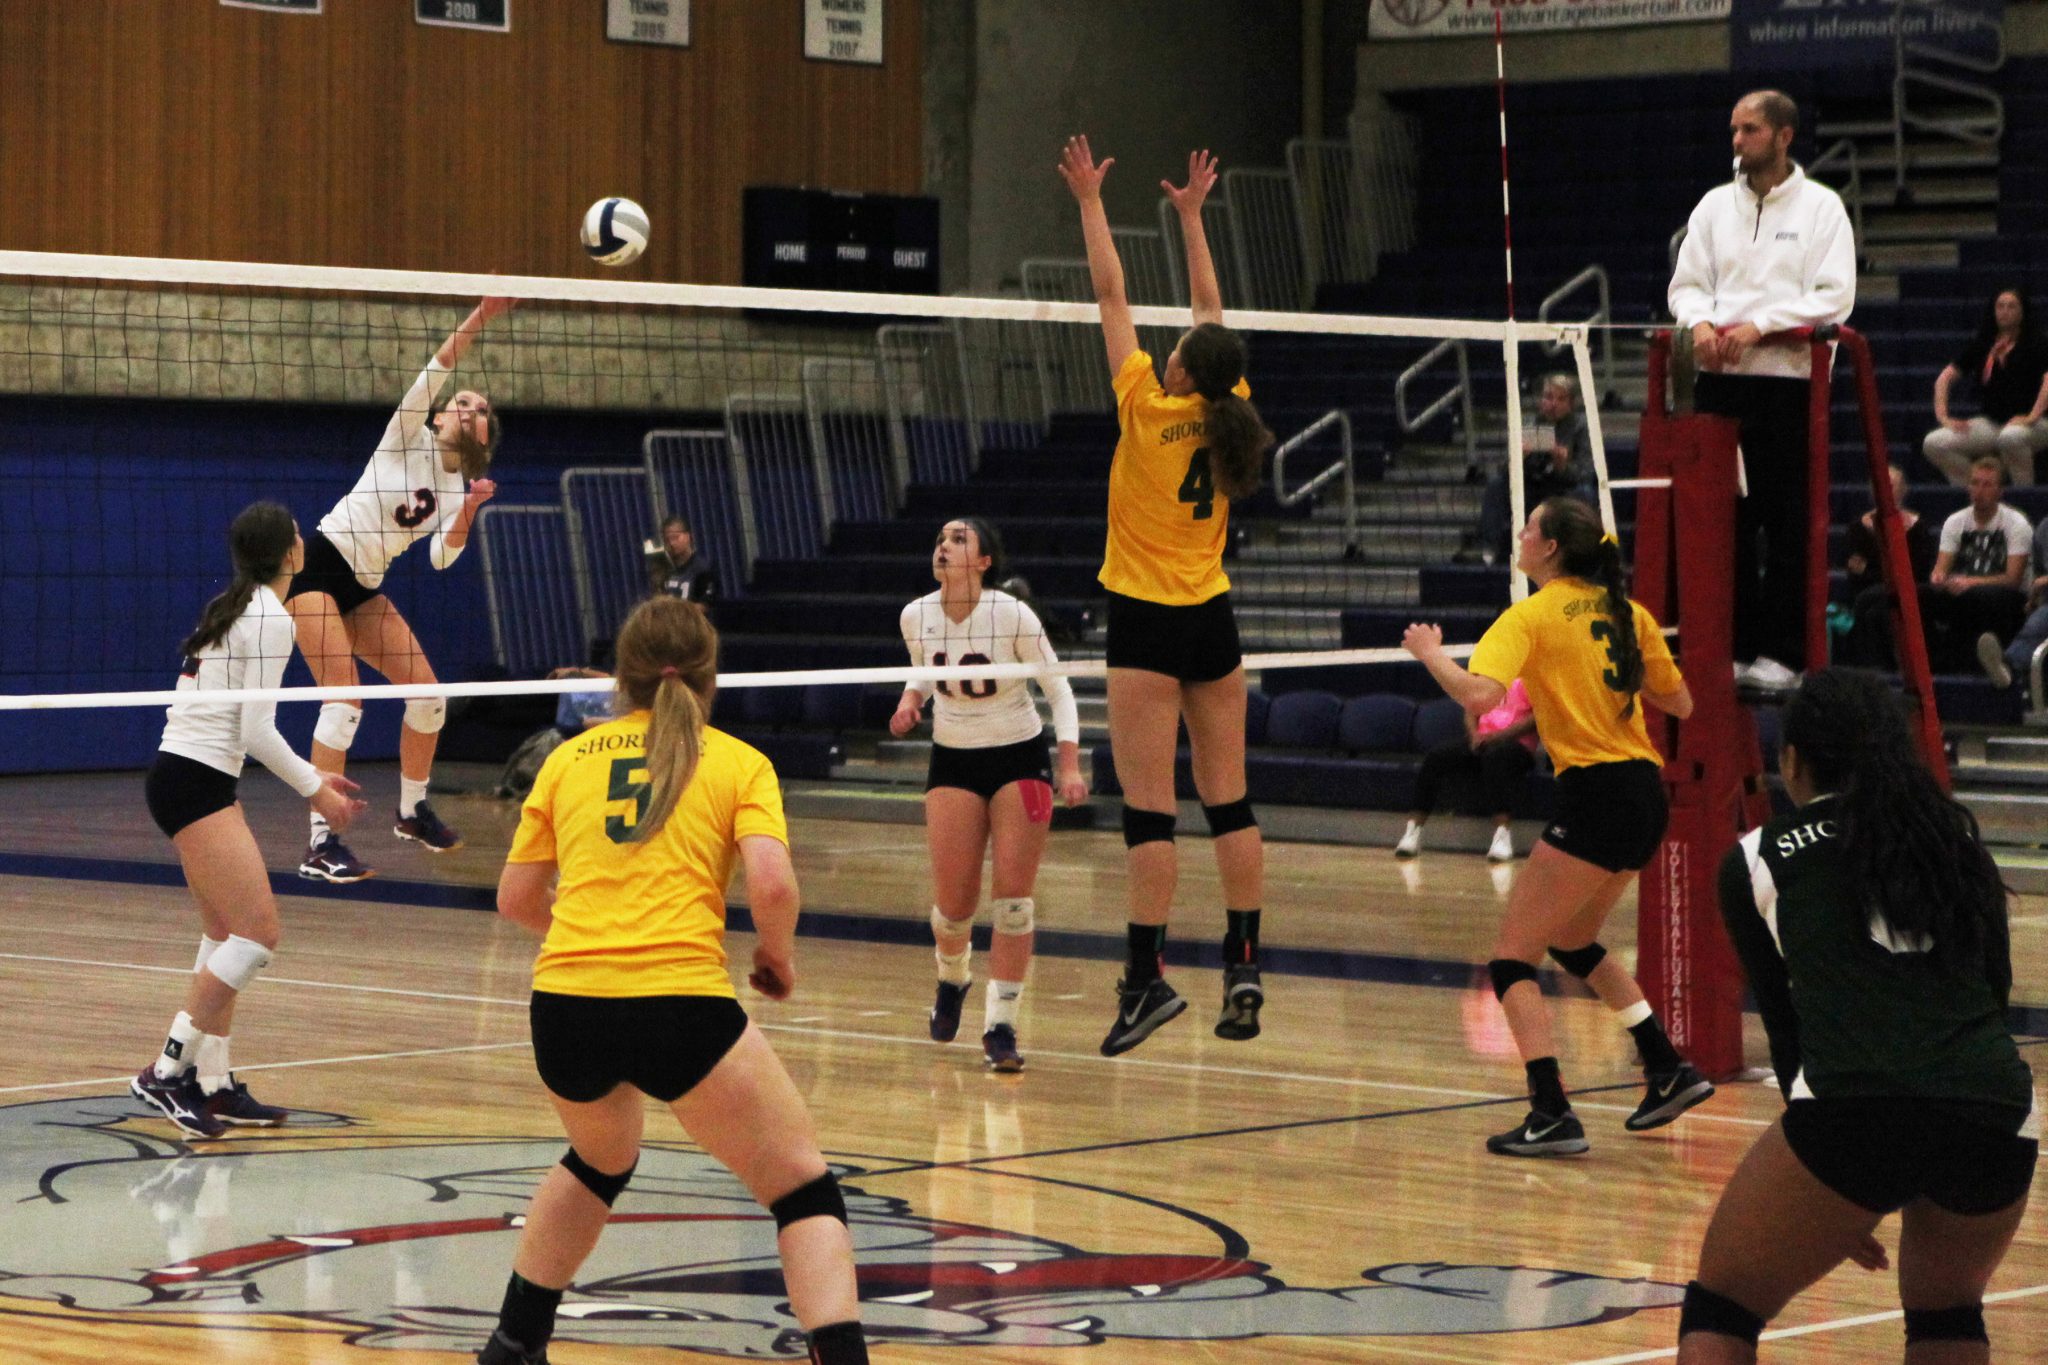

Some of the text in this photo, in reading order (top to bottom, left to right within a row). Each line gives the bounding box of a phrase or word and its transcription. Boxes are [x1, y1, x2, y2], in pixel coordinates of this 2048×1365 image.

[1448, 0, 1727, 28] wwwadvantagebasketball.com
[1750, 19, 1805, 42] where
[1813, 15, 1927, 39] informaton
[775, 243, 806, 262] HOME
[893, 250, 926, 268] GUEST
[1178, 447, 1215, 520] 4
[394, 488, 436, 528] 3
[1590, 620, 1624, 692] 3
[605, 757, 652, 844] 5
